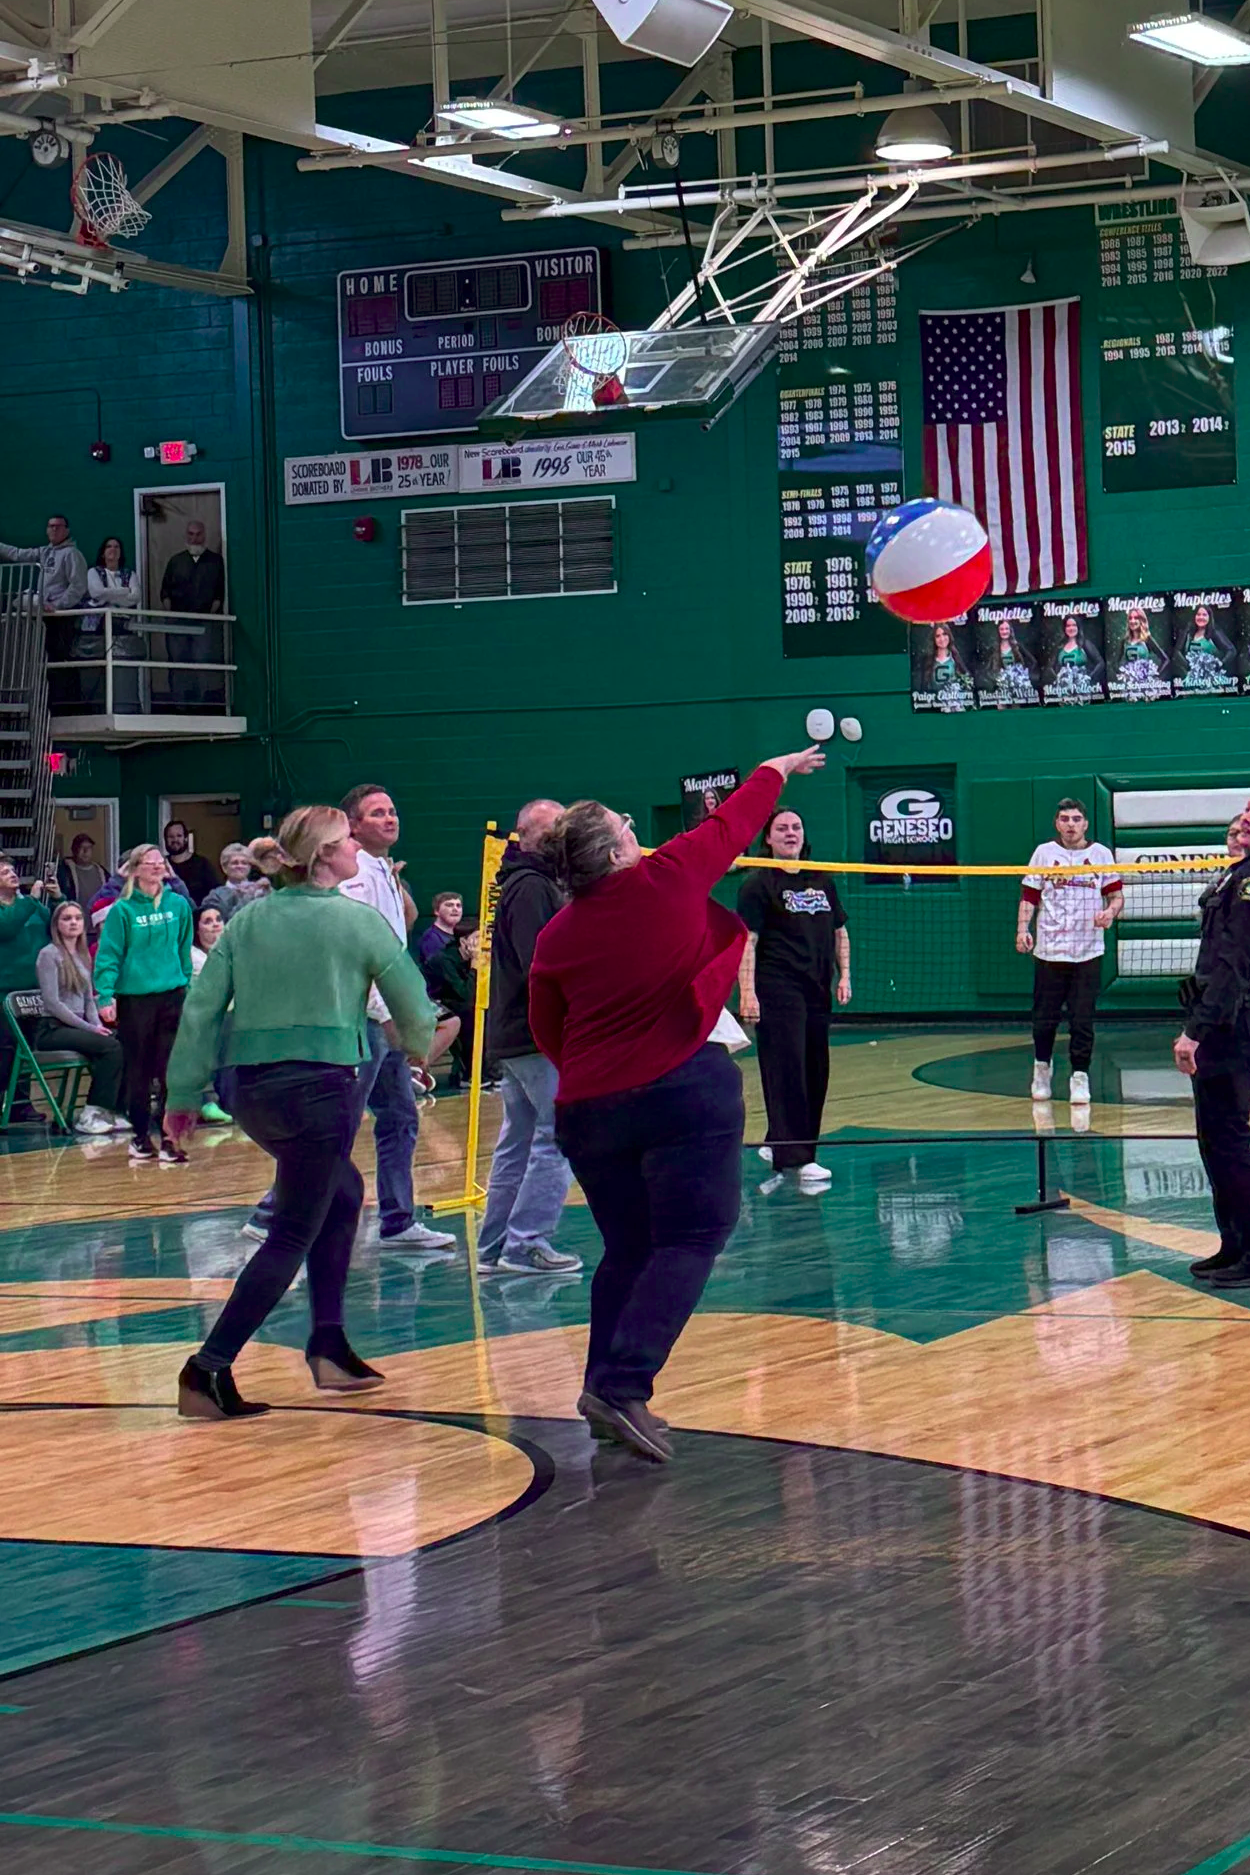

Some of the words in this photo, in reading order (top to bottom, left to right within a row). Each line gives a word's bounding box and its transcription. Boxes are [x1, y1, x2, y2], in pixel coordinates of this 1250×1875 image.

[534, 254, 594, 278] VISITOR
[346, 273, 398, 296] HOME
[364, 339, 403, 357] BONUS
[438, 333, 475, 350] PERIOD
[357, 366, 393, 382] FOULS
[430, 359, 474, 377] PLAYER
[483, 355, 520, 372] FOULS
[1104, 425, 1135, 439] STATE
[1149, 419, 1180, 436] 2013
[1192, 416, 1223, 432] 2014
[482, 446, 524, 458] Scoreboard
[576, 450, 593, 463] OUR
[1106, 440, 1136, 456] 2015
[291, 460, 346, 479] SCOREBOARD
[532, 455, 573, 478] 1998
[583, 464, 607, 478] YEAR
[291, 481, 329, 497] DONATED
[784, 561, 812, 574] STATE
[825, 557, 852, 572] 1976
[1108, 596, 1166, 613] Maplettes
[1173, 591, 1232, 610] Maplettes
[826, 606, 855, 622] 2013
[978, 606, 1033, 624] Maplettes
[1043, 601, 1100, 619] Maplettes
[684, 772, 737, 793] Maplettes
[869, 818, 953, 842] GENESEO
